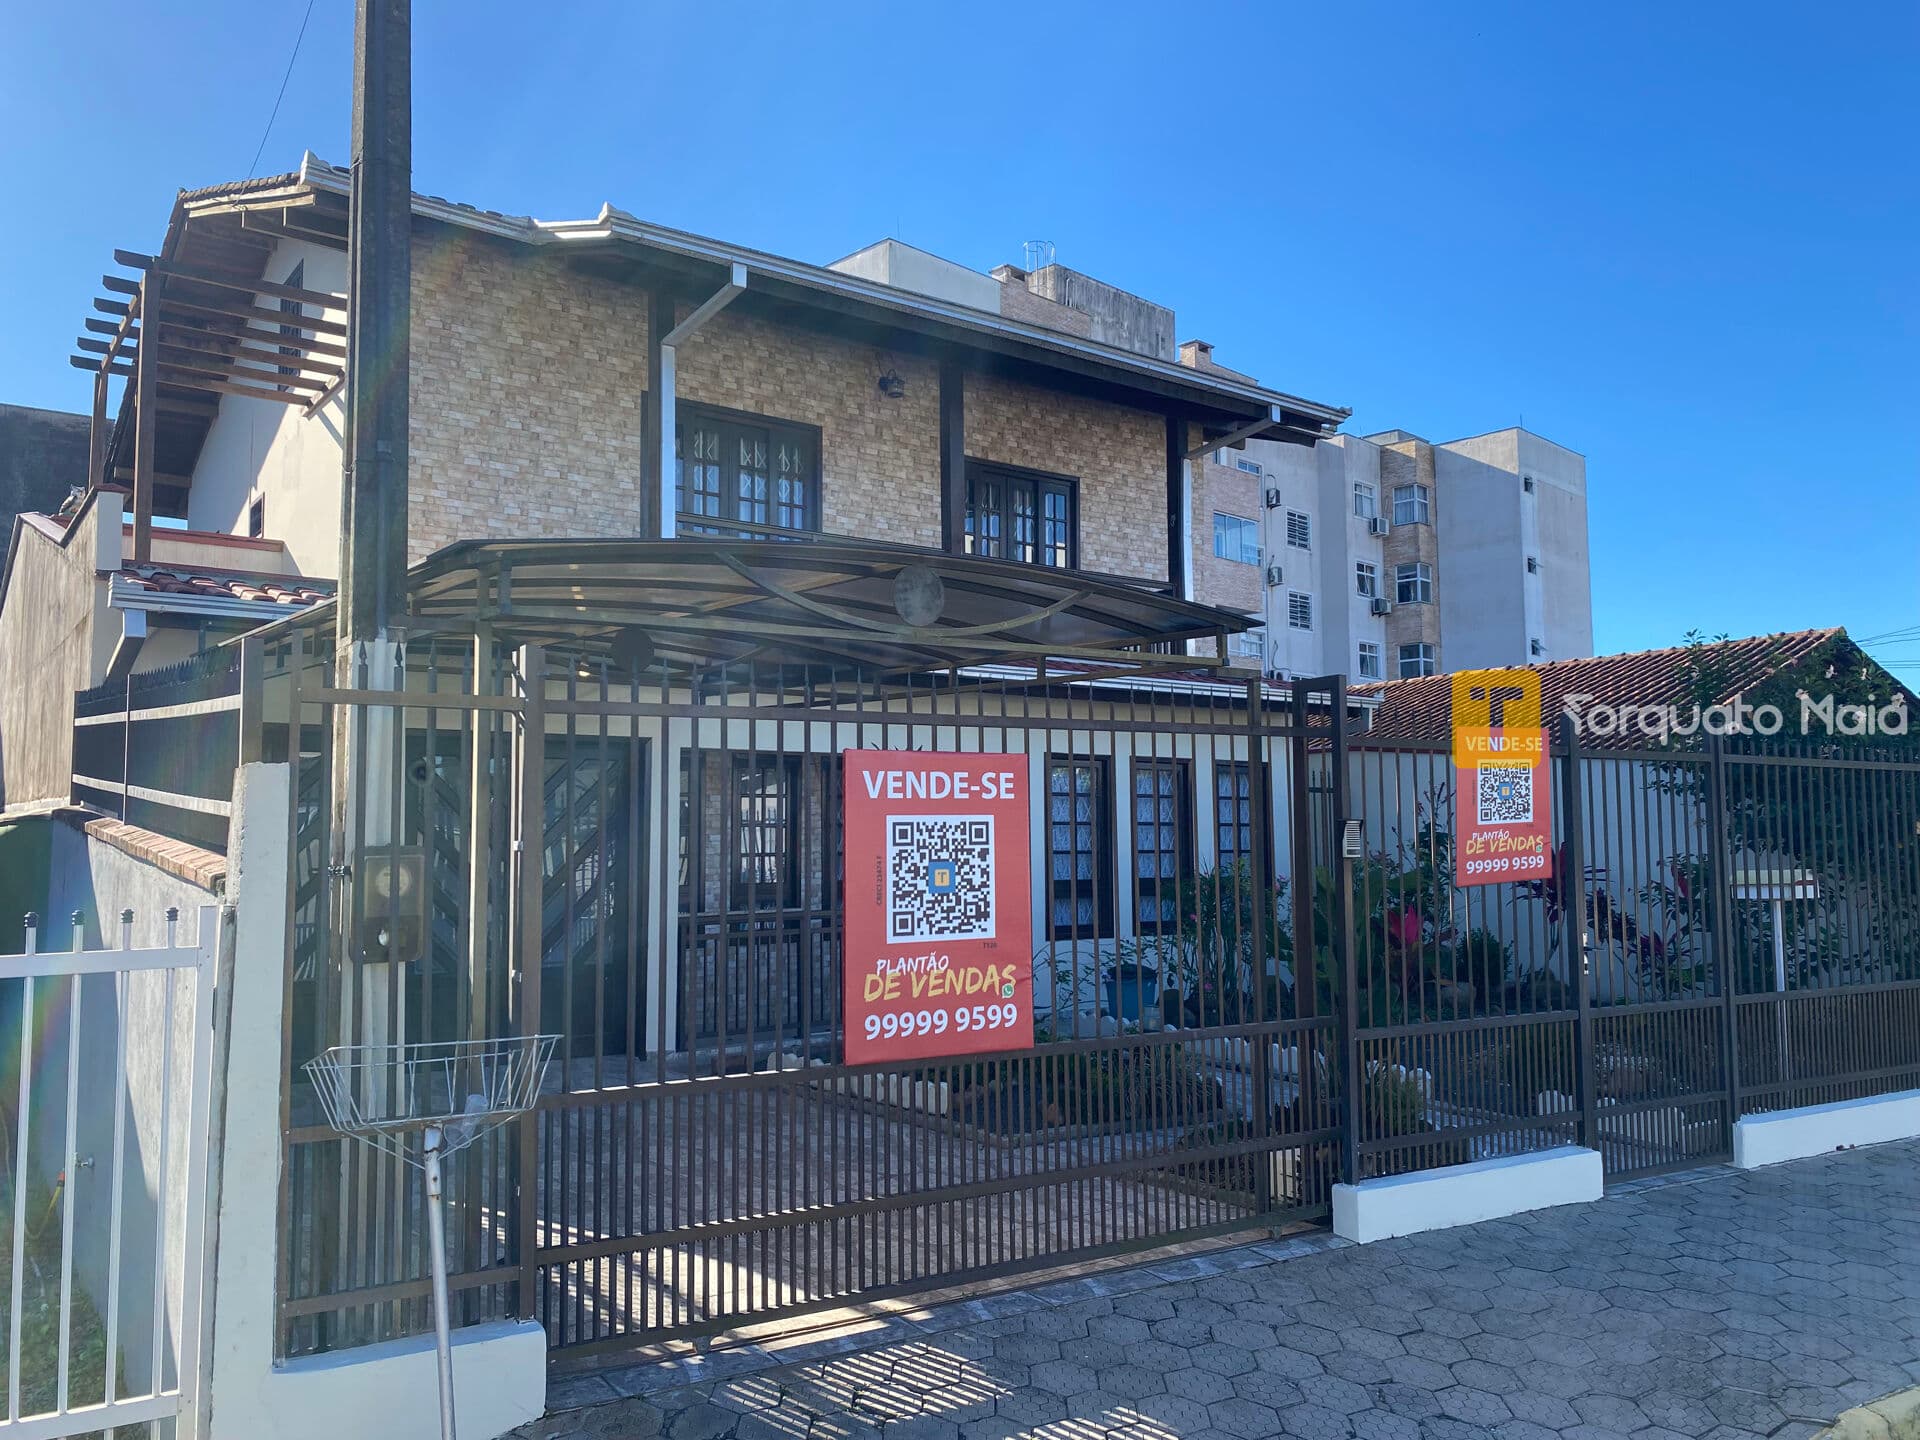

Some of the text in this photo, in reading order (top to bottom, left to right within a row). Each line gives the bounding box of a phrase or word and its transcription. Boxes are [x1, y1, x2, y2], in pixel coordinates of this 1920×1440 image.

[1465, 735, 1543, 752] VENDE-SE
[862, 770, 1015, 799] VENDE-SE
[1466, 834, 1544, 855] DE VENDAS
[1472, 829, 1510, 841] PLANTÃO
[1466, 855, 1545, 874] 99999 9599
[876, 951, 949, 976] PLANTÃO
[864, 964, 1017, 1003] DE VENDAS
[864, 1003, 1018, 1041] 99999 9599
